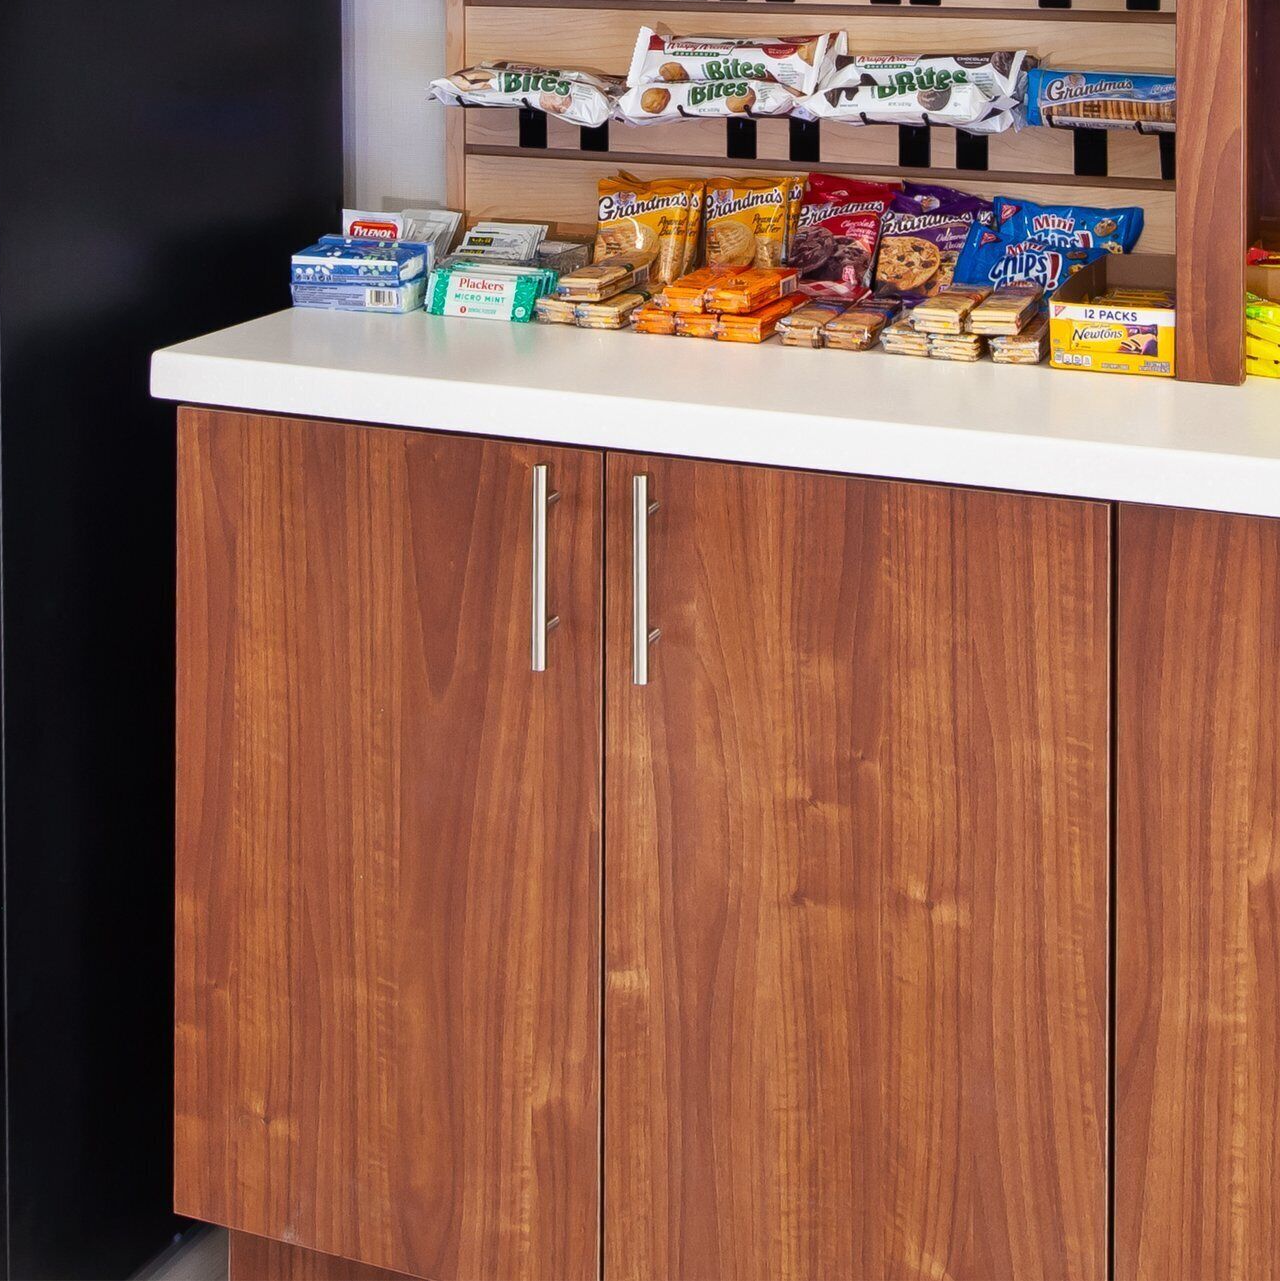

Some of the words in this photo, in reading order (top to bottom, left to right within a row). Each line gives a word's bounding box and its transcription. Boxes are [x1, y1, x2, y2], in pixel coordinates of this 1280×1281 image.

[707, 60, 766, 80] Bites
[691, 81, 748, 105] Bites
[1047, 79, 1133, 101] Grandma's
[599, 193, 688, 220] Grandma's
[1033, 215, 1075, 230] Mini
[459, 278, 504, 291] Plackers
[455, 293, 481, 302] MICRO
[485, 295, 505, 303] MINT
[1084, 308, 1095, 319] 12
[1099, 310, 1137, 322] PACKS
[1072, 327, 1122, 341] Newtons
